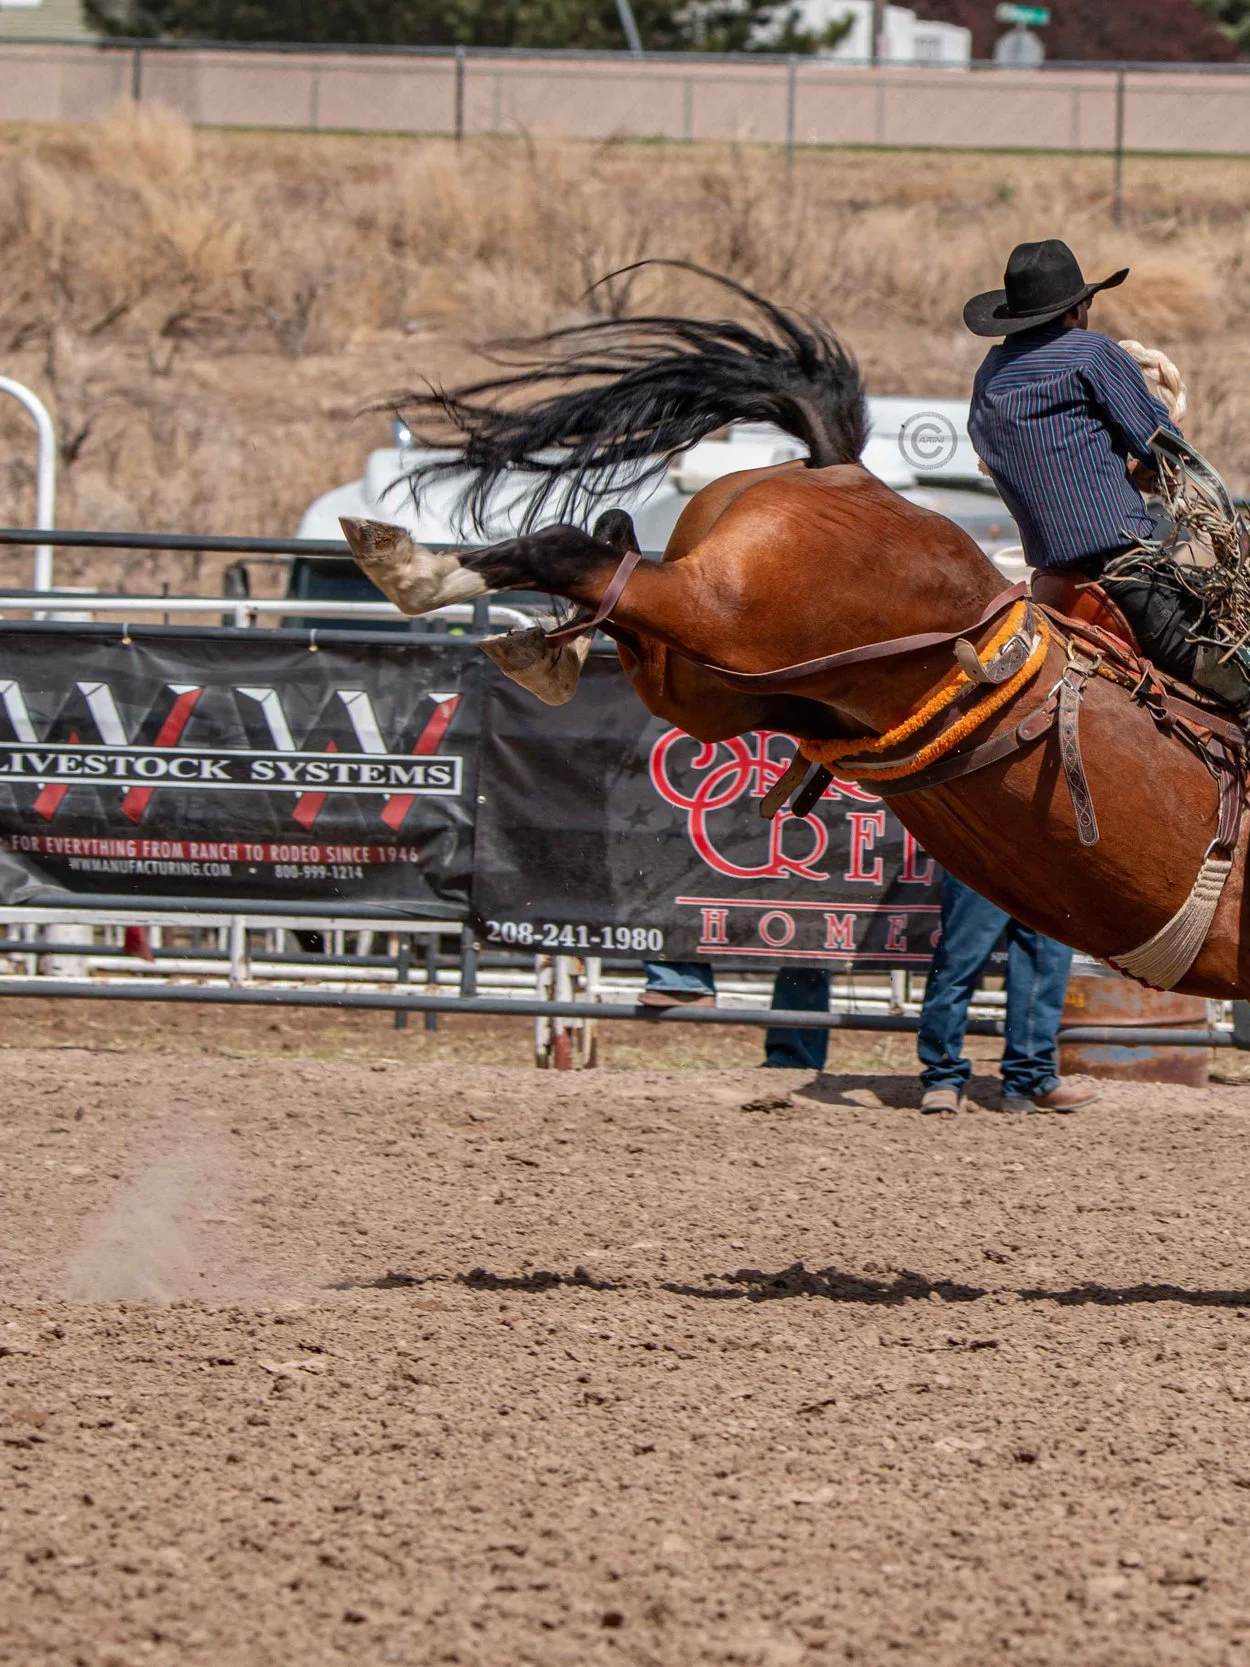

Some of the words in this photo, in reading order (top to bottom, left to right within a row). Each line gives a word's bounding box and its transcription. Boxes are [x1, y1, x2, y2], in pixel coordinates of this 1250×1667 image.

[250, 760, 452, 785] SYSTEMS
[12, 835, 40, 851] FOR
[46, 836, 137, 857] EVERYTHING
[143, 840, 184, 858] FROM
[191, 842, 238, 860] RANCH
[244, 844, 263, 861] TO
[271, 845, 320, 862] RODEO
[327, 846, 371, 863] SINCE
[379, 847, 419, 863] 1946
[274, 864, 363, 879] 800-999-1214
[485, 920, 664, 951] 208-241-1980
